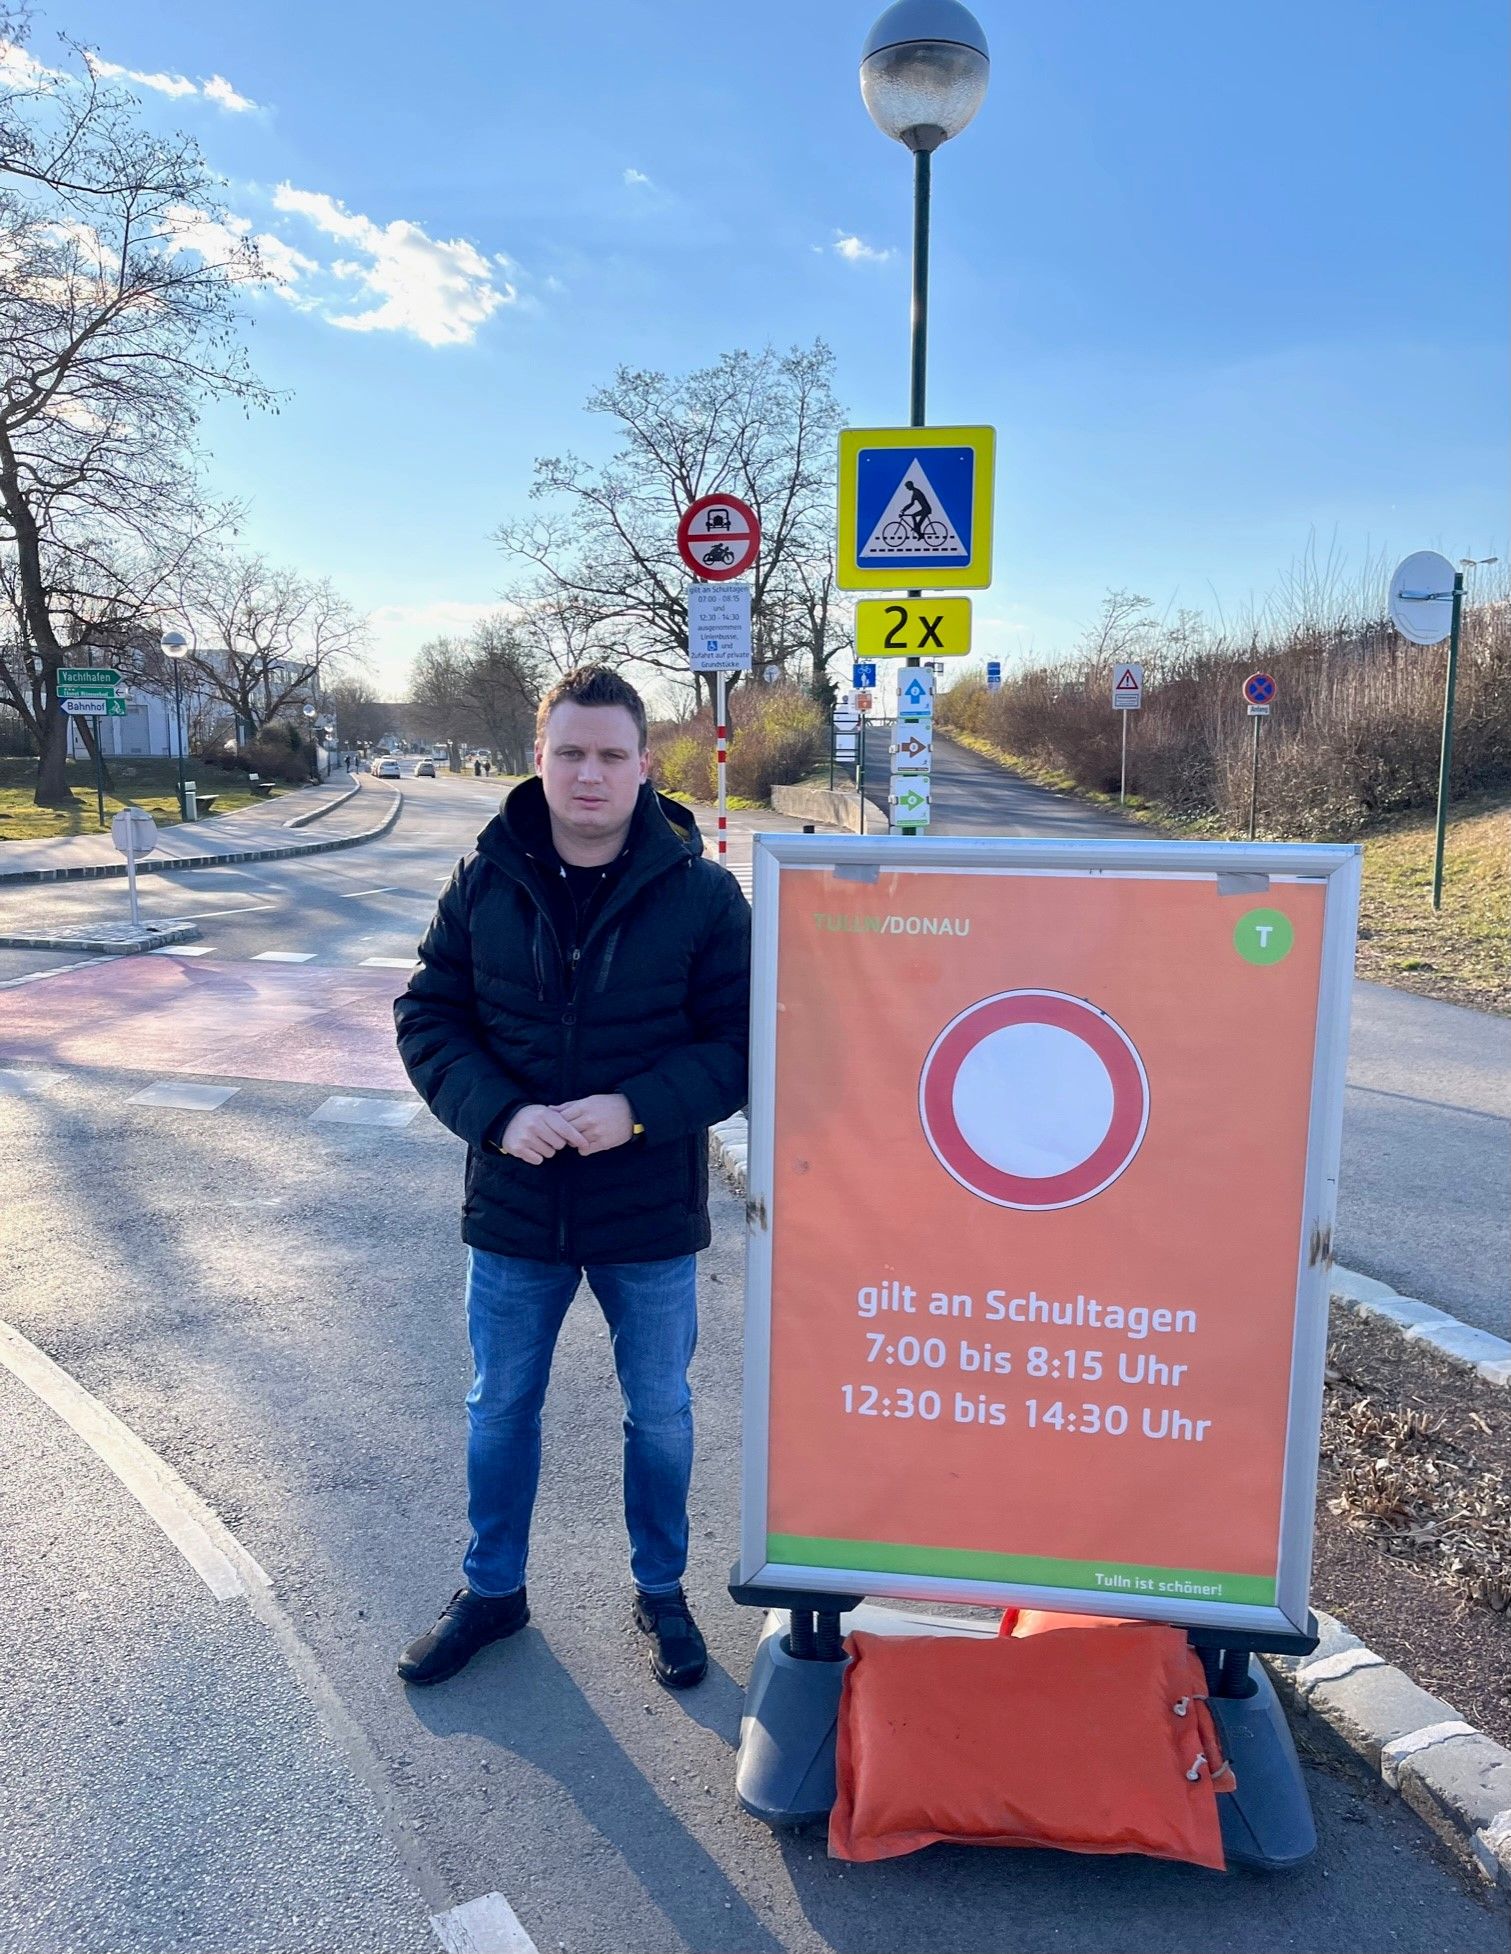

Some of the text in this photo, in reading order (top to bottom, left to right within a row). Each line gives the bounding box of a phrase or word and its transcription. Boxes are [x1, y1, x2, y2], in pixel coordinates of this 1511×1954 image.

[62, 671, 111, 682] Yachthafen
[67, 701, 105, 711] Bahnhof
[1255, 926, 1273, 948] T
[857, 1281, 1197, 1339] gilt an Schultagen
[865, 1333, 1188, 1386] 7:00 bis 8:15 Uhr
[841, 1385, 1212, 1442] 12:30 bis 14:30 Uhr
[1095, 1573, 1222, 1596] Tulln ist schöner!
